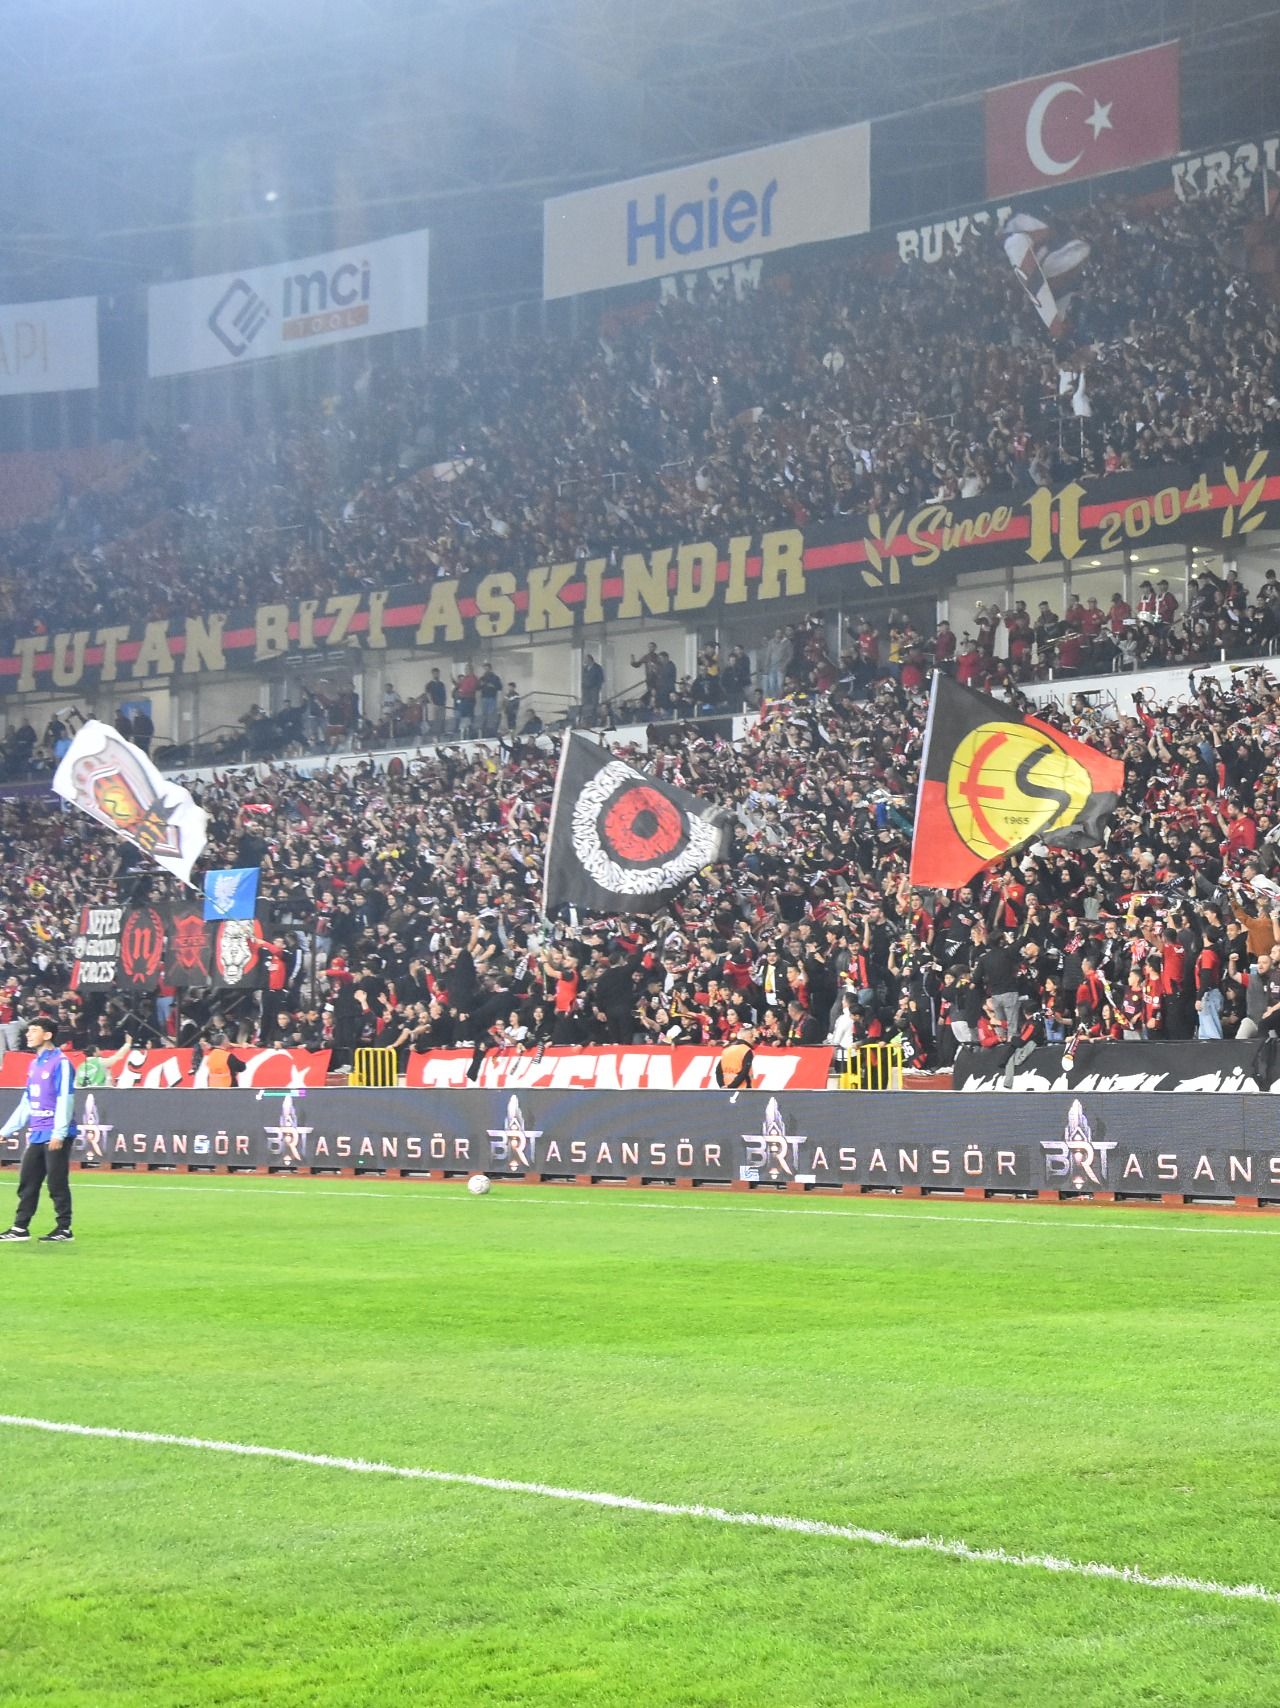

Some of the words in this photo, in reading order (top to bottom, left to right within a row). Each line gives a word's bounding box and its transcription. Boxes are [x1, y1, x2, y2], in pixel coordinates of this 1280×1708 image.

[626, 176, 778, 266] Haier
[283, 258, 371, 318] mci
[907, 504, 1013, 567] Since
[1100, 473, 1213, 551] 2004
[14, 613, 227, 692] TUTAN
[1004, 815, 1030, 826] 1965
[114, 1130, 250, 1155] ASANSÖR
[314, 1133, 471, 1160] ASANSÖR
[545, 1135, 723, 1167] ASANSÖR
[812, 1139, 1018, 1177] ASANSÖR
